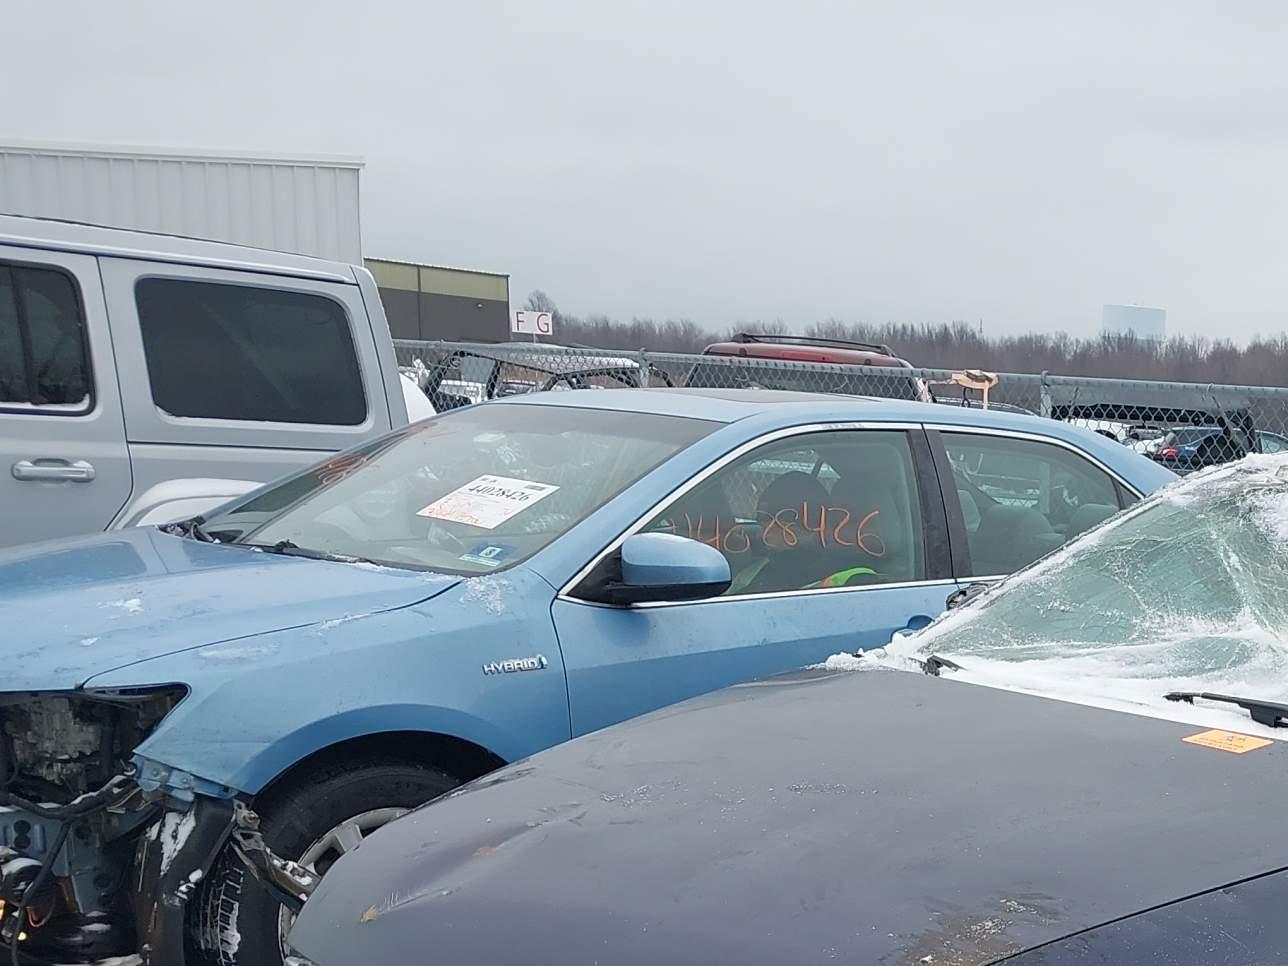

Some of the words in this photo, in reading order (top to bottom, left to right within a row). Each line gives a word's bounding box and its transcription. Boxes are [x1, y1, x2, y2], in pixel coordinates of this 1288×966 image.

[516, 311, 525, 331] F
[536, 313, 549, 333] G
[482, 657, 538, 675] HYBRID
